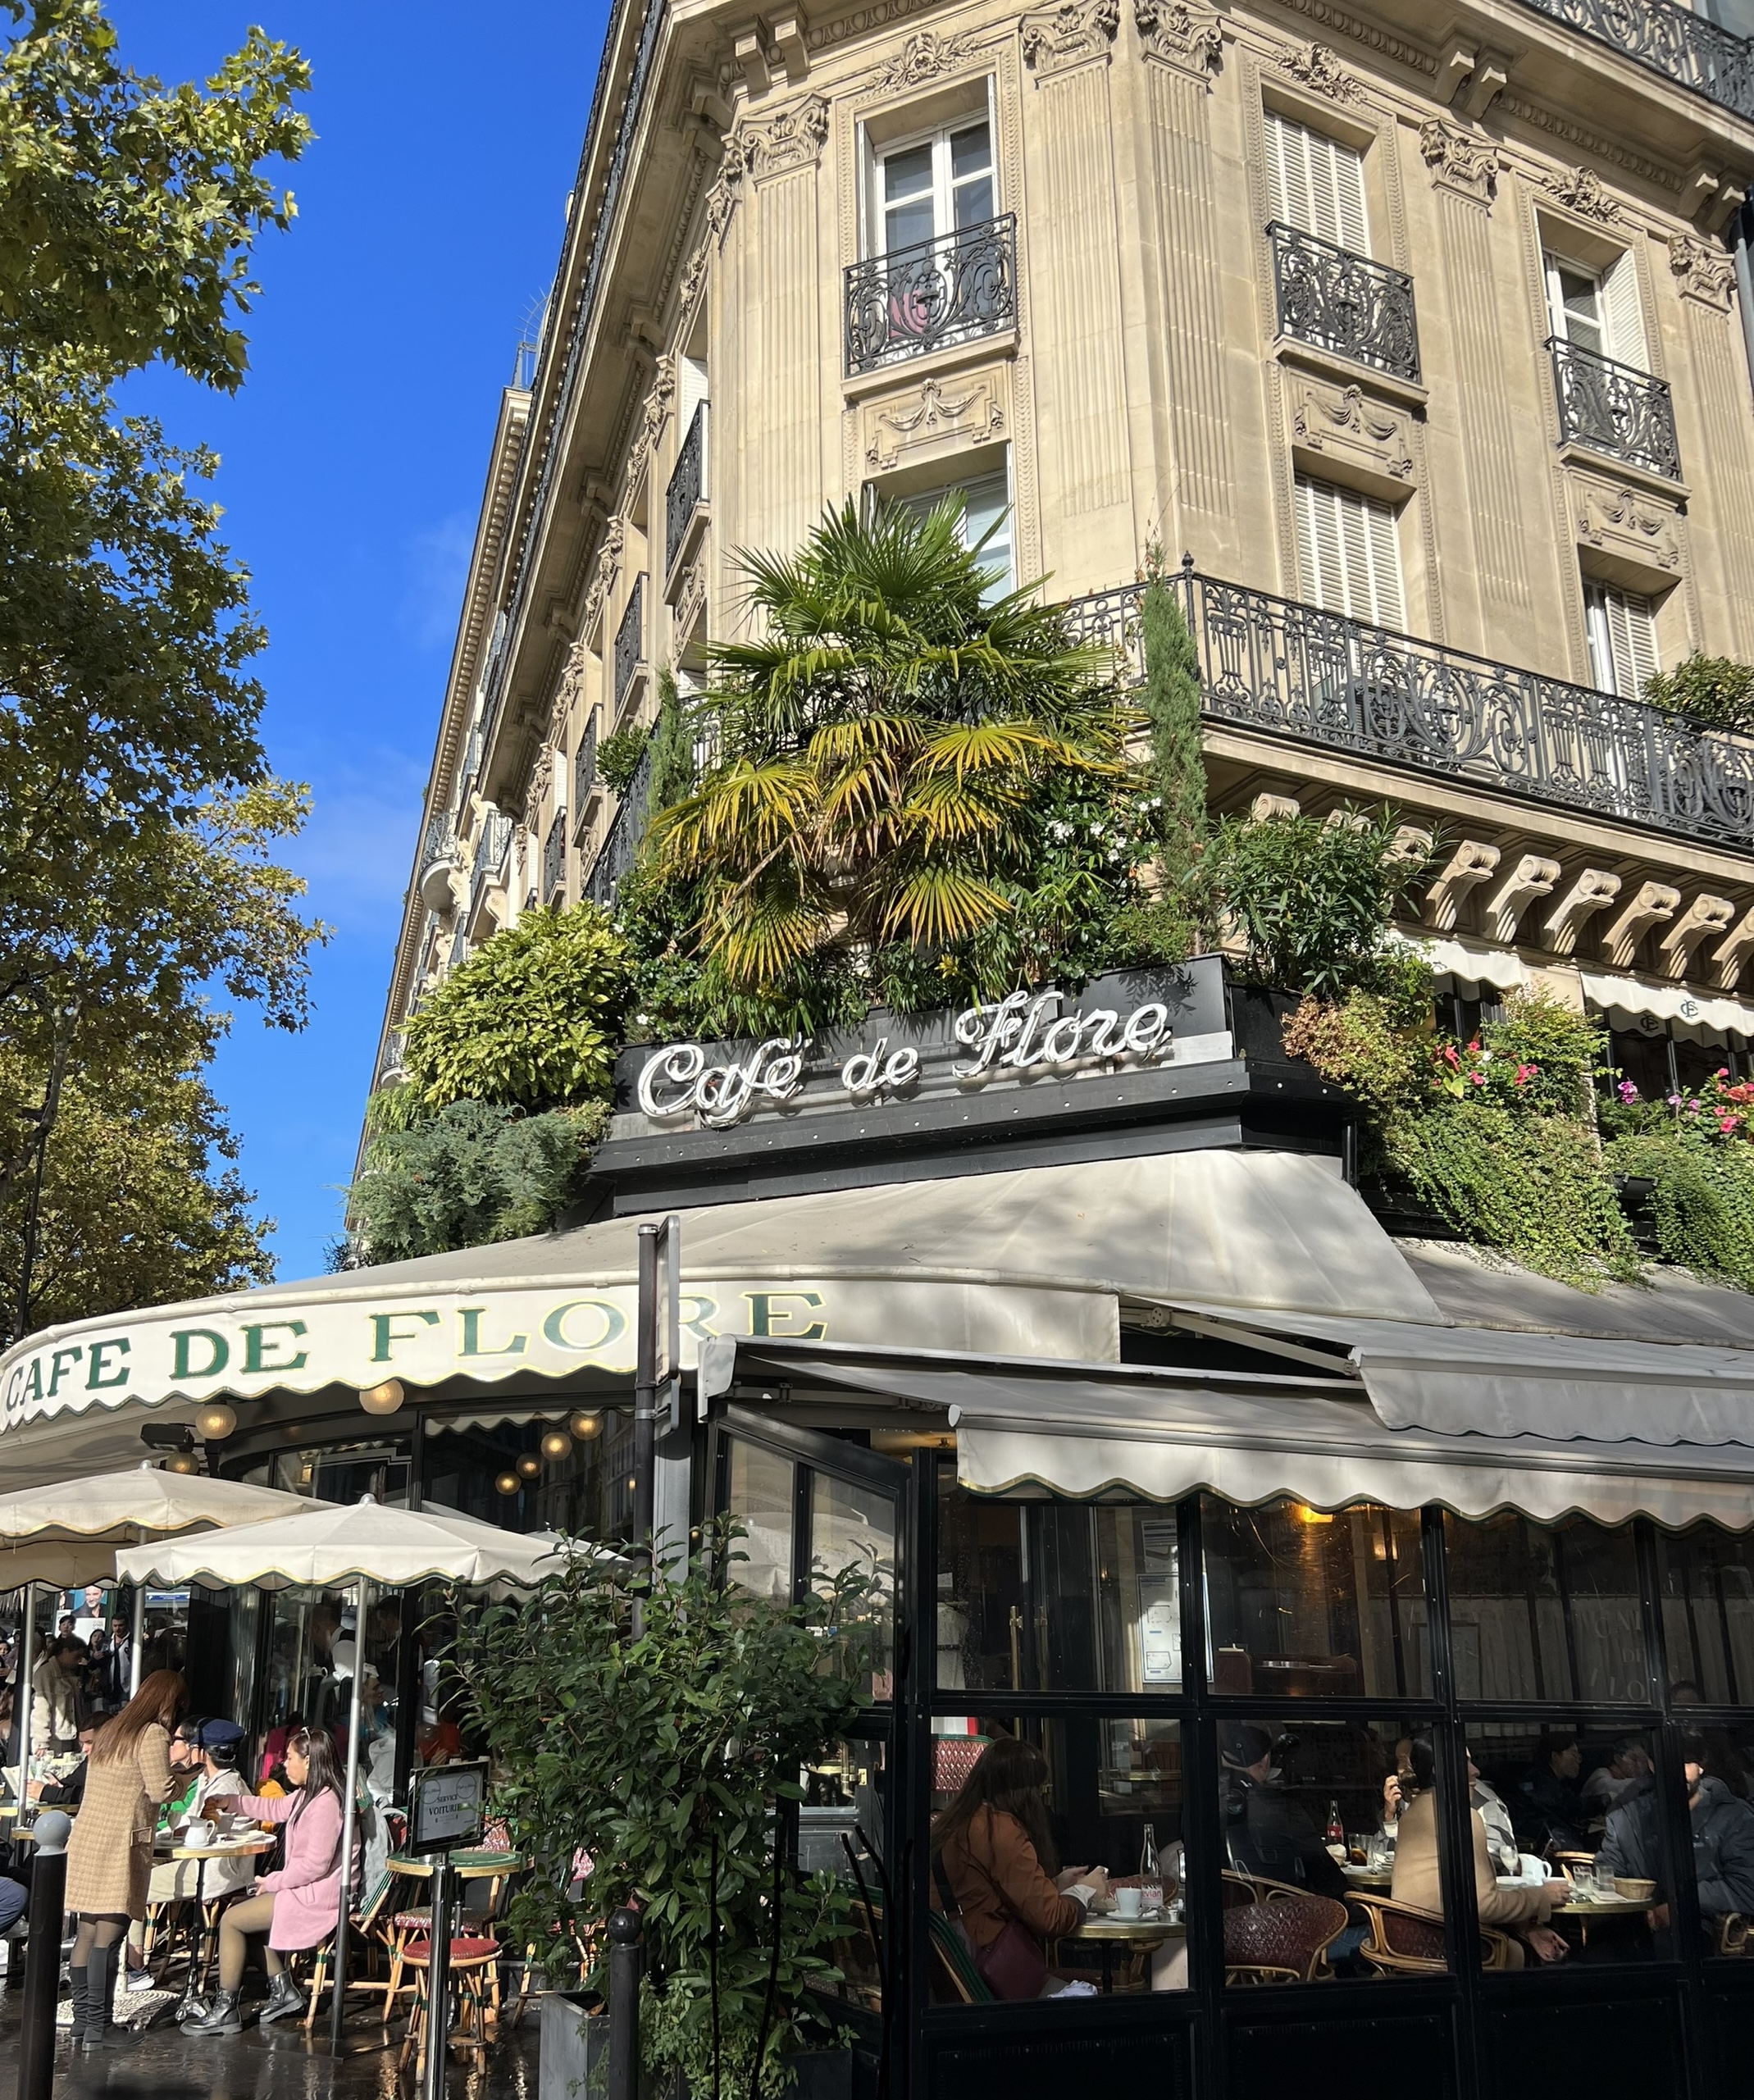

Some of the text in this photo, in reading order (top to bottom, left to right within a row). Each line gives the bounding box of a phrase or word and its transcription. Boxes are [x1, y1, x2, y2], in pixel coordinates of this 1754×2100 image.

[638, 990, 1173, 1127] Café de Flore
[6, 1290, 828, 1412] CAFE DE FLORE
[437, 1793, 458, 1803] SERVICE
